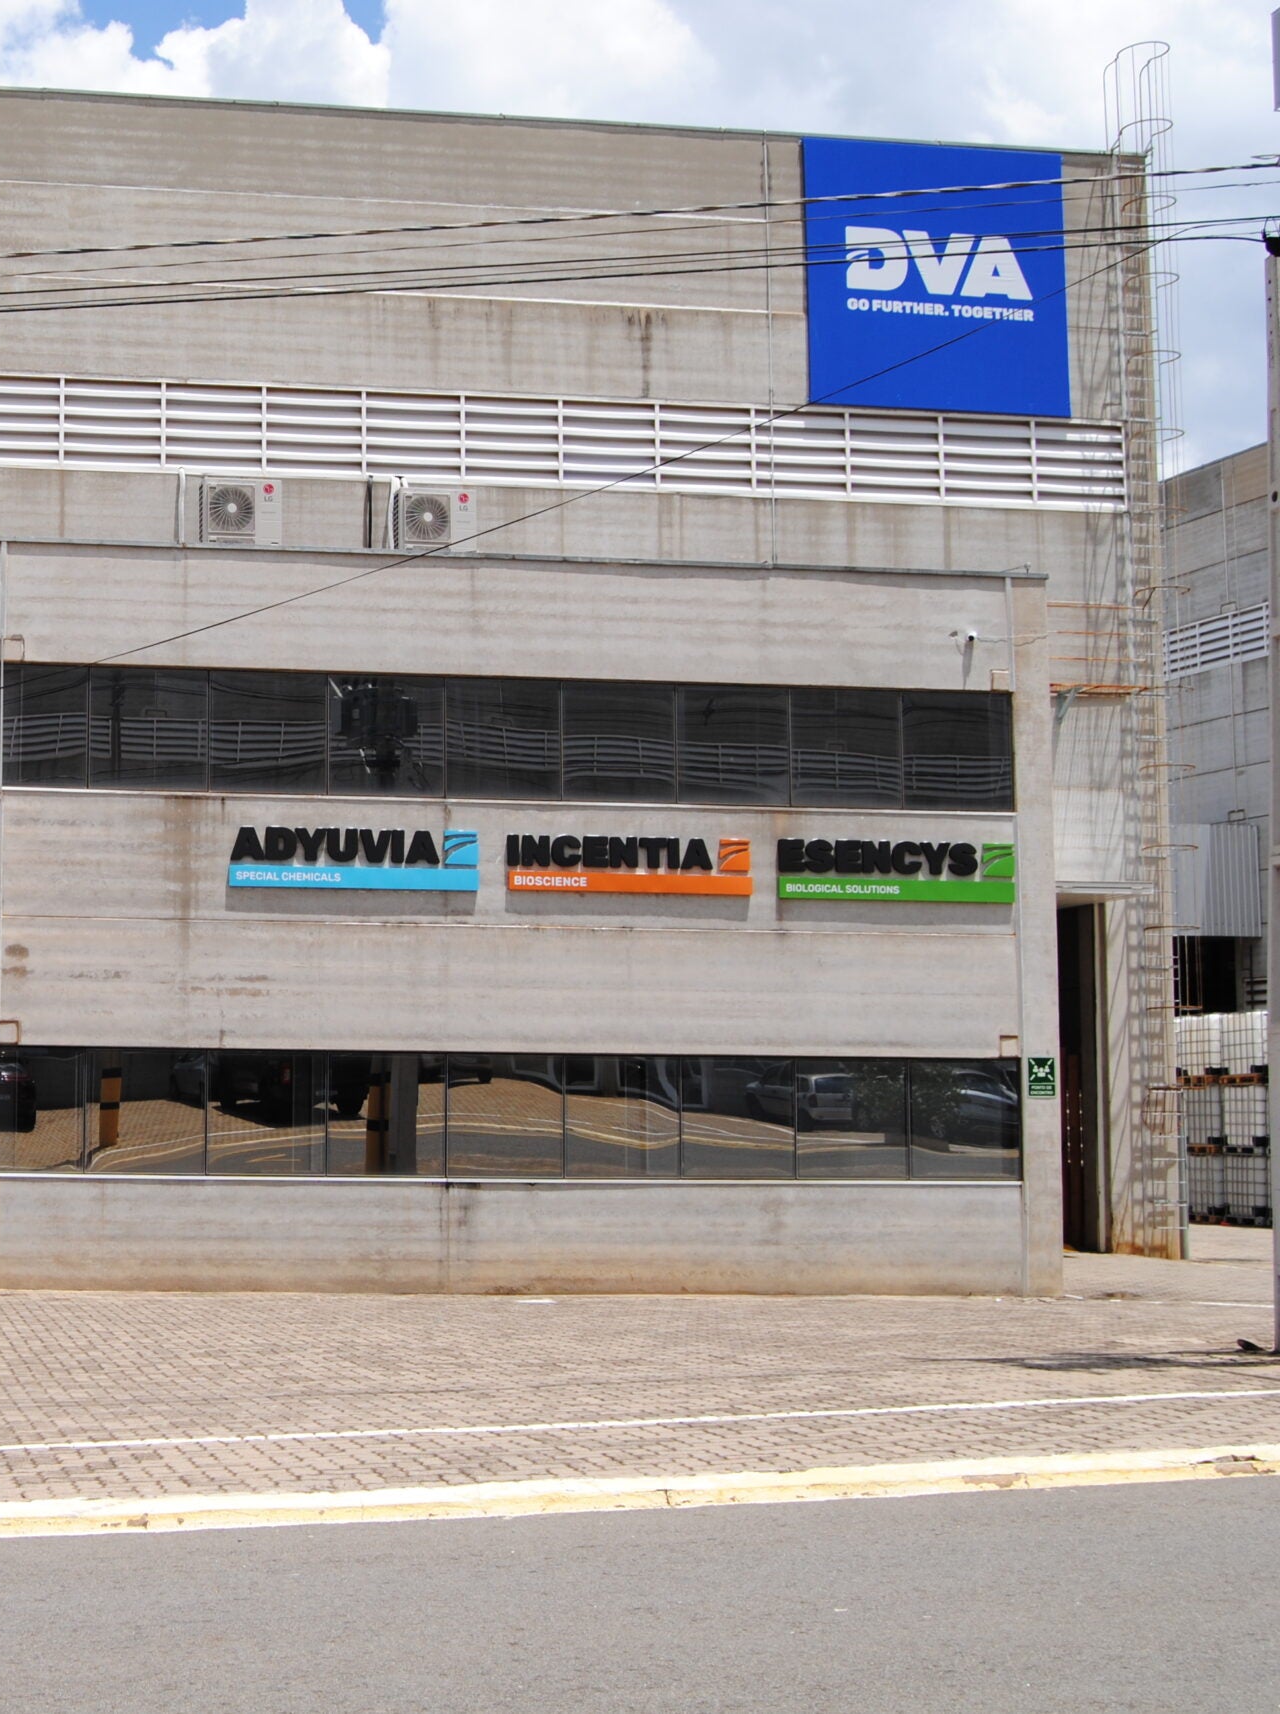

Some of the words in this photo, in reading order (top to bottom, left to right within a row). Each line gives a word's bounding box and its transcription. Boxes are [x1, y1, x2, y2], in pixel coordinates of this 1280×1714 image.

[845, 226, 1033, 301] DVA
[847, 298, 870, 311] GO
[872, 299, 949, 317] FURTHER.
[951, 304, 1035, 322] TOGETHER
[231, 826, 440, 864] ADYUVIA
[507, 834, 713, 870] INCENTIA
[777, 838, 978, 876] ESENCYS
[235, 871, 280, 882] SPECIAL
[281, 871, 342, 882] CHEMICALS
[513, 875, 588, 887] BIOSCIENCE
[785, 883, 844, 894] BIOLOGICAL
[845, 884, 901, 895] SOLUTIONS
